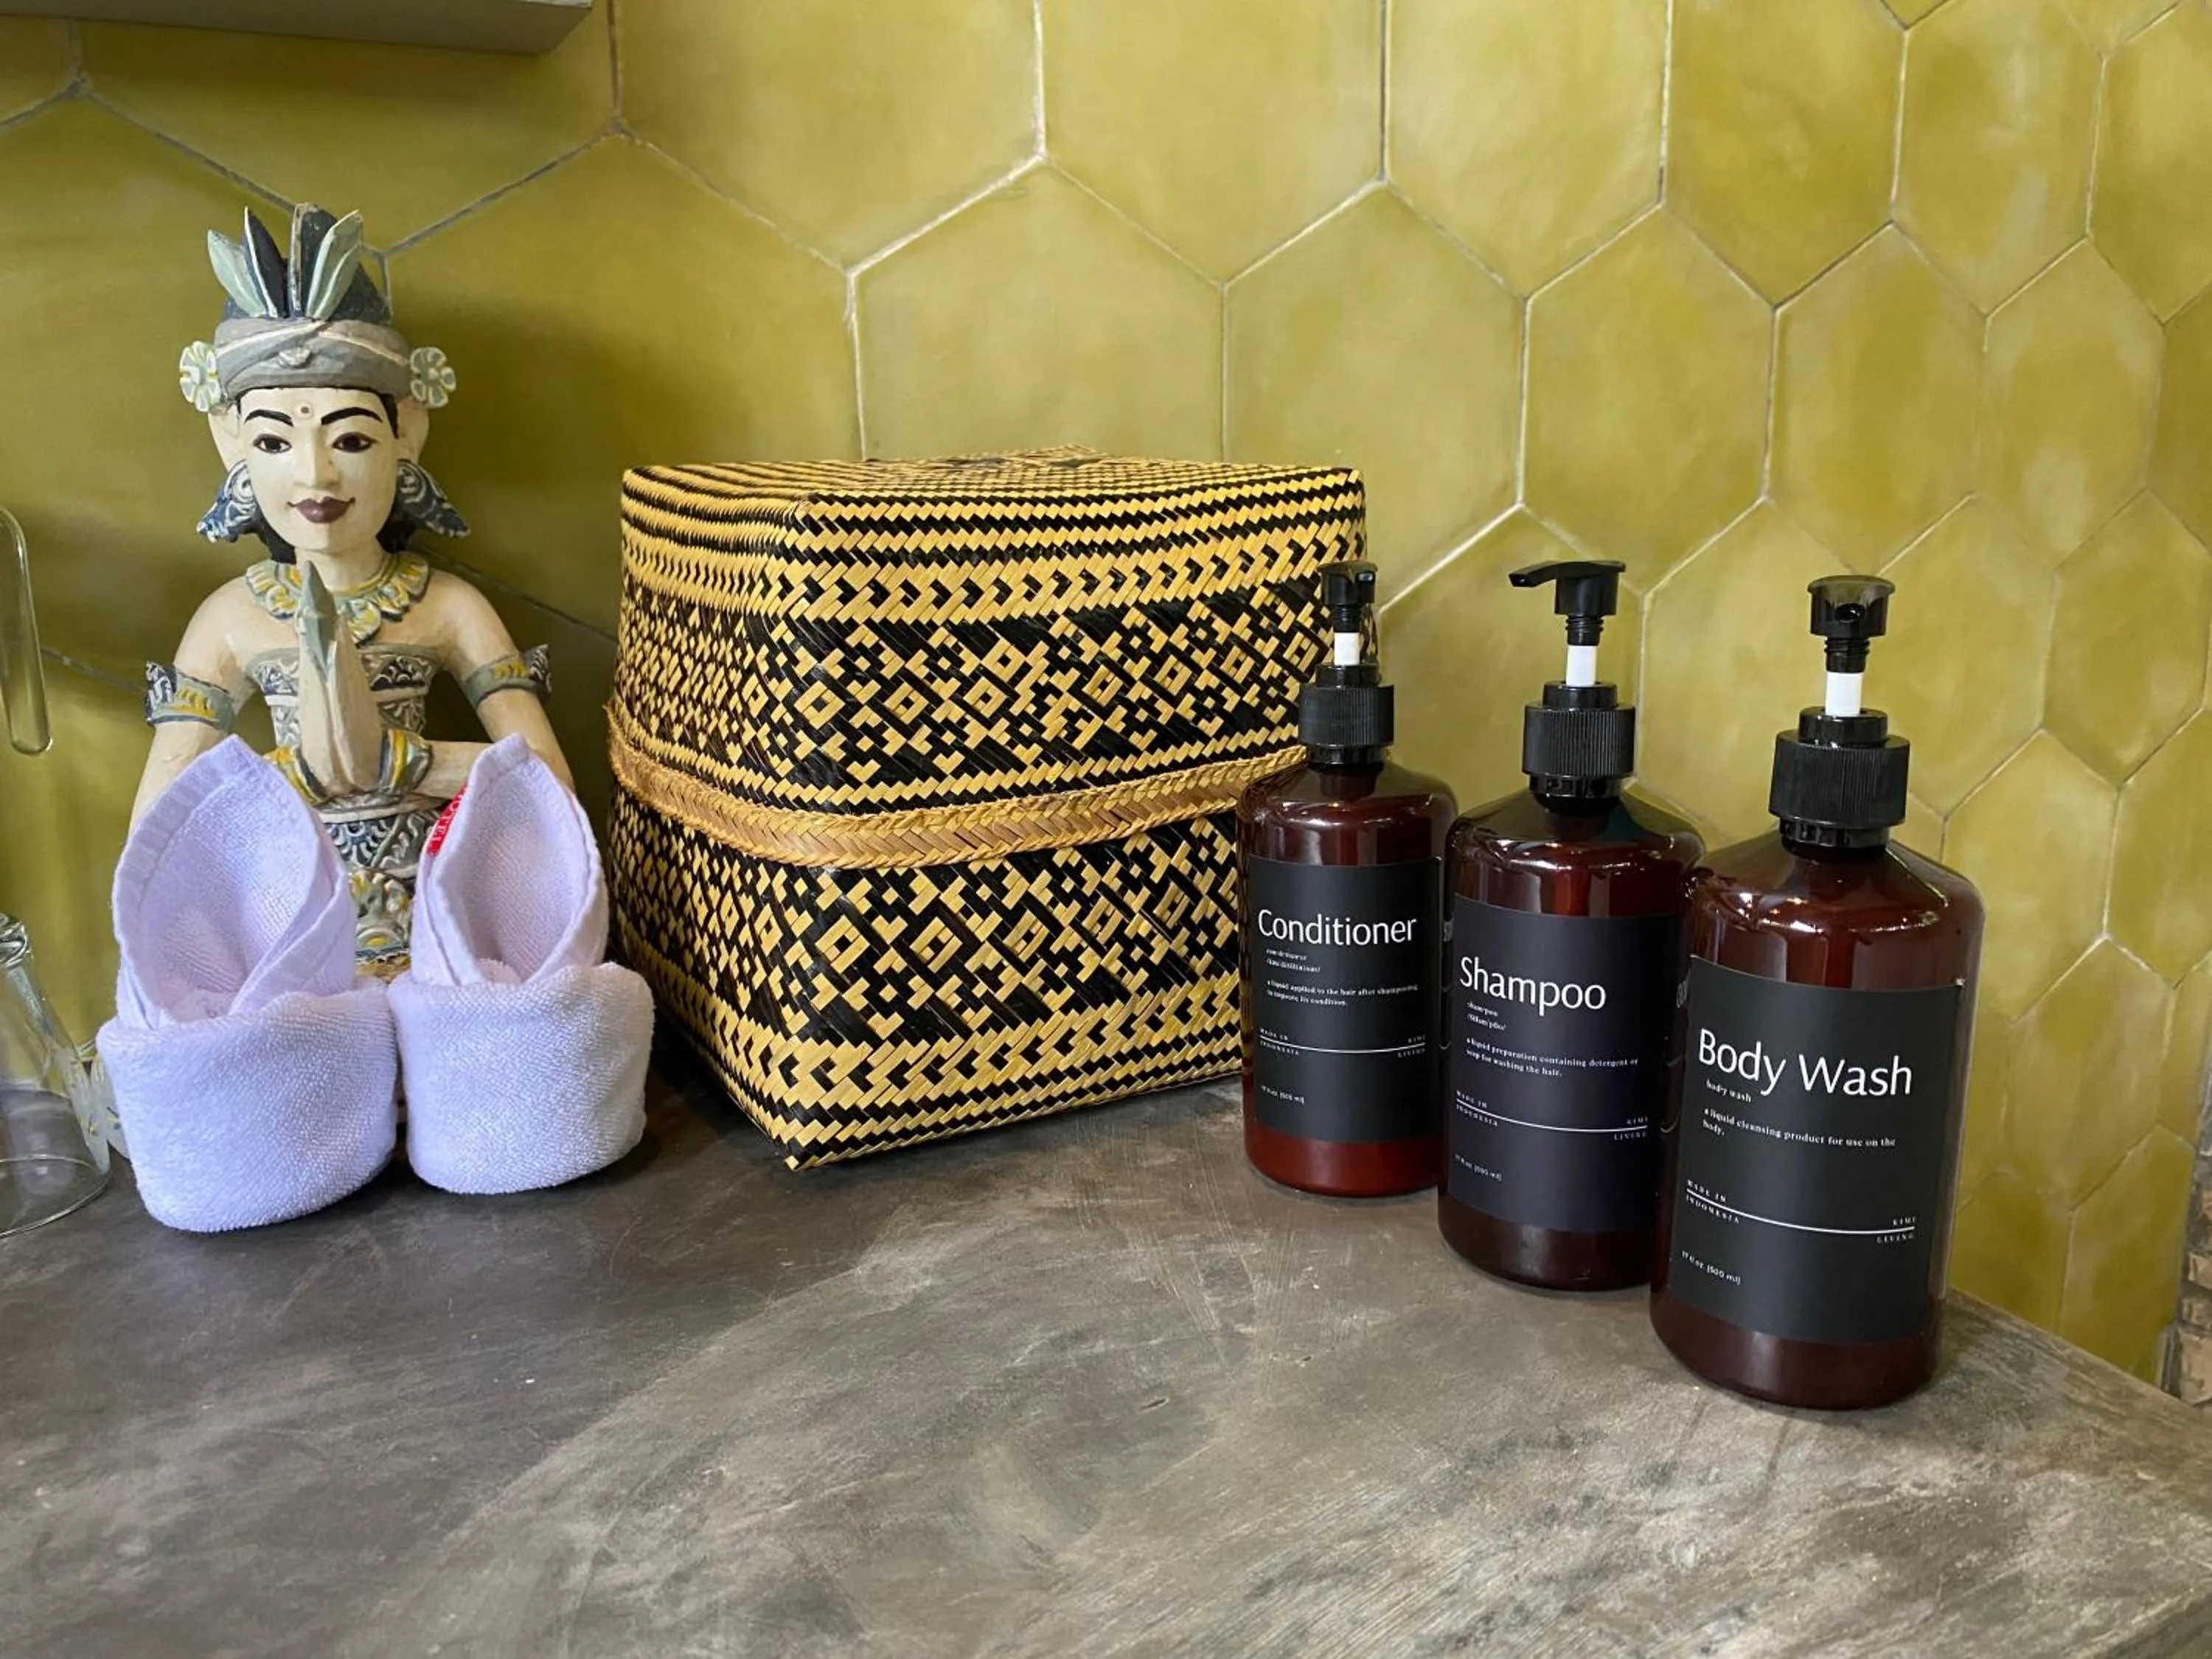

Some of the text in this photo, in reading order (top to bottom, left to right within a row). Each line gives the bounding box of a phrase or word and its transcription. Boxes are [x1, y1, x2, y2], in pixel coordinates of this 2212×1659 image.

[1258, 908, 1416, 945] Conditioner
[1290, 985, 1316, 993] applied
[1460, 956, 1606, 1016] Shampoo
[1471, 1038, 1490, 1051] liquid
[1492, 1046, 1537, 1062] preparation
[1540, 1057, 1587, 1068] containing
[1589, 1058, 1628, 1068] detergent
[1493, 1059, 1525, 1072] washing
[1526, 1065, 1540, 1074] the
[1542, 1067, 1562, 1077] hair.
[1699, 1028, 1912, 1096] Body Wash
[1729, 1090, 1751, 1102] wash
[1710, 1108, 1735, 1125] liquid
[1736, 1120, 1781, 1138] cleansing
[1784, 1132, 1825, 1144] product
[1828, 1135, 1843, 1145] for
[1846, 1138, 1863, 1147] use
[1880, 1138, 1896, 1147] the
[1686, 1194, 1740, 1225] INDONESIA
